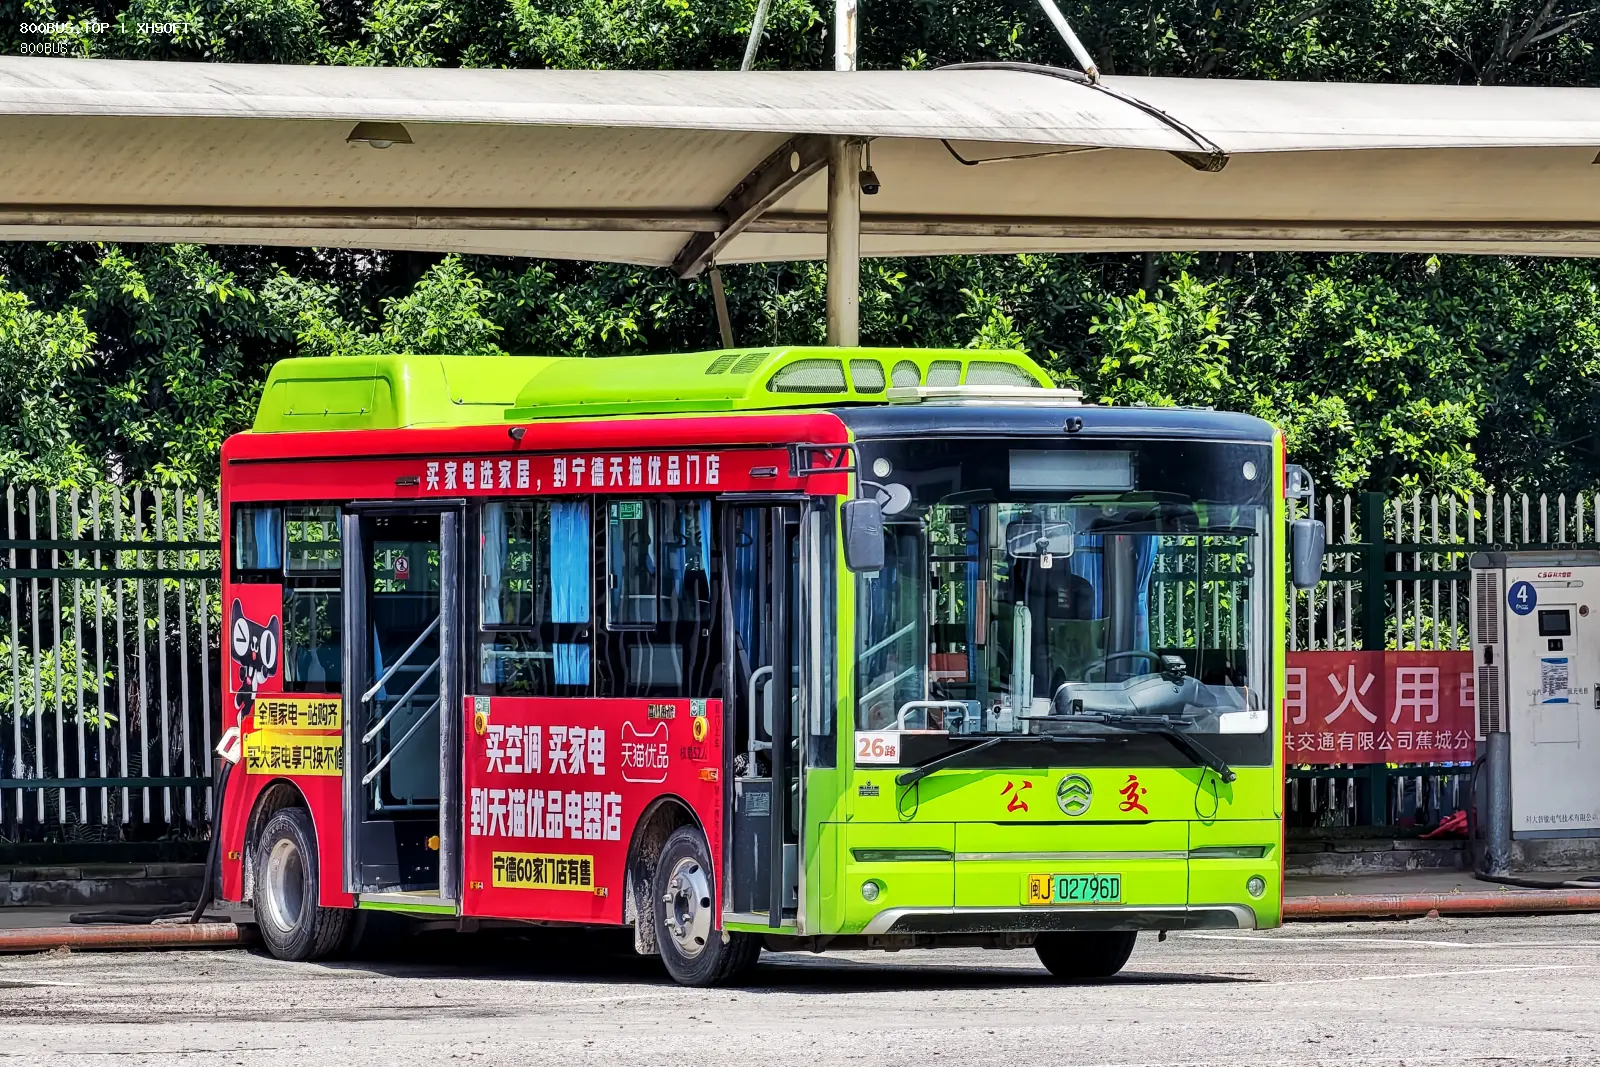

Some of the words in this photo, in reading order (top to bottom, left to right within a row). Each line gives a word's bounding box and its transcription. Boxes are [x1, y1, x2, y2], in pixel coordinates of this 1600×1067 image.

[1517, 585, 1528, 603] 4
[258, 702, 338, 726] 全屋家电一站购齐
[247, 745, 343, 770] 买大家电享只换不修
[486, 724, 542, 774] 买空调
[548, 726, 606, 775] 买家电
[621, 743, 669, 769] 天猫优品
[858, 737, 896, 757] 26路
[470, 787, 622, 841] 到天猫优品电器店
[493, 856, 591, 886] 宁德60家门店有售
